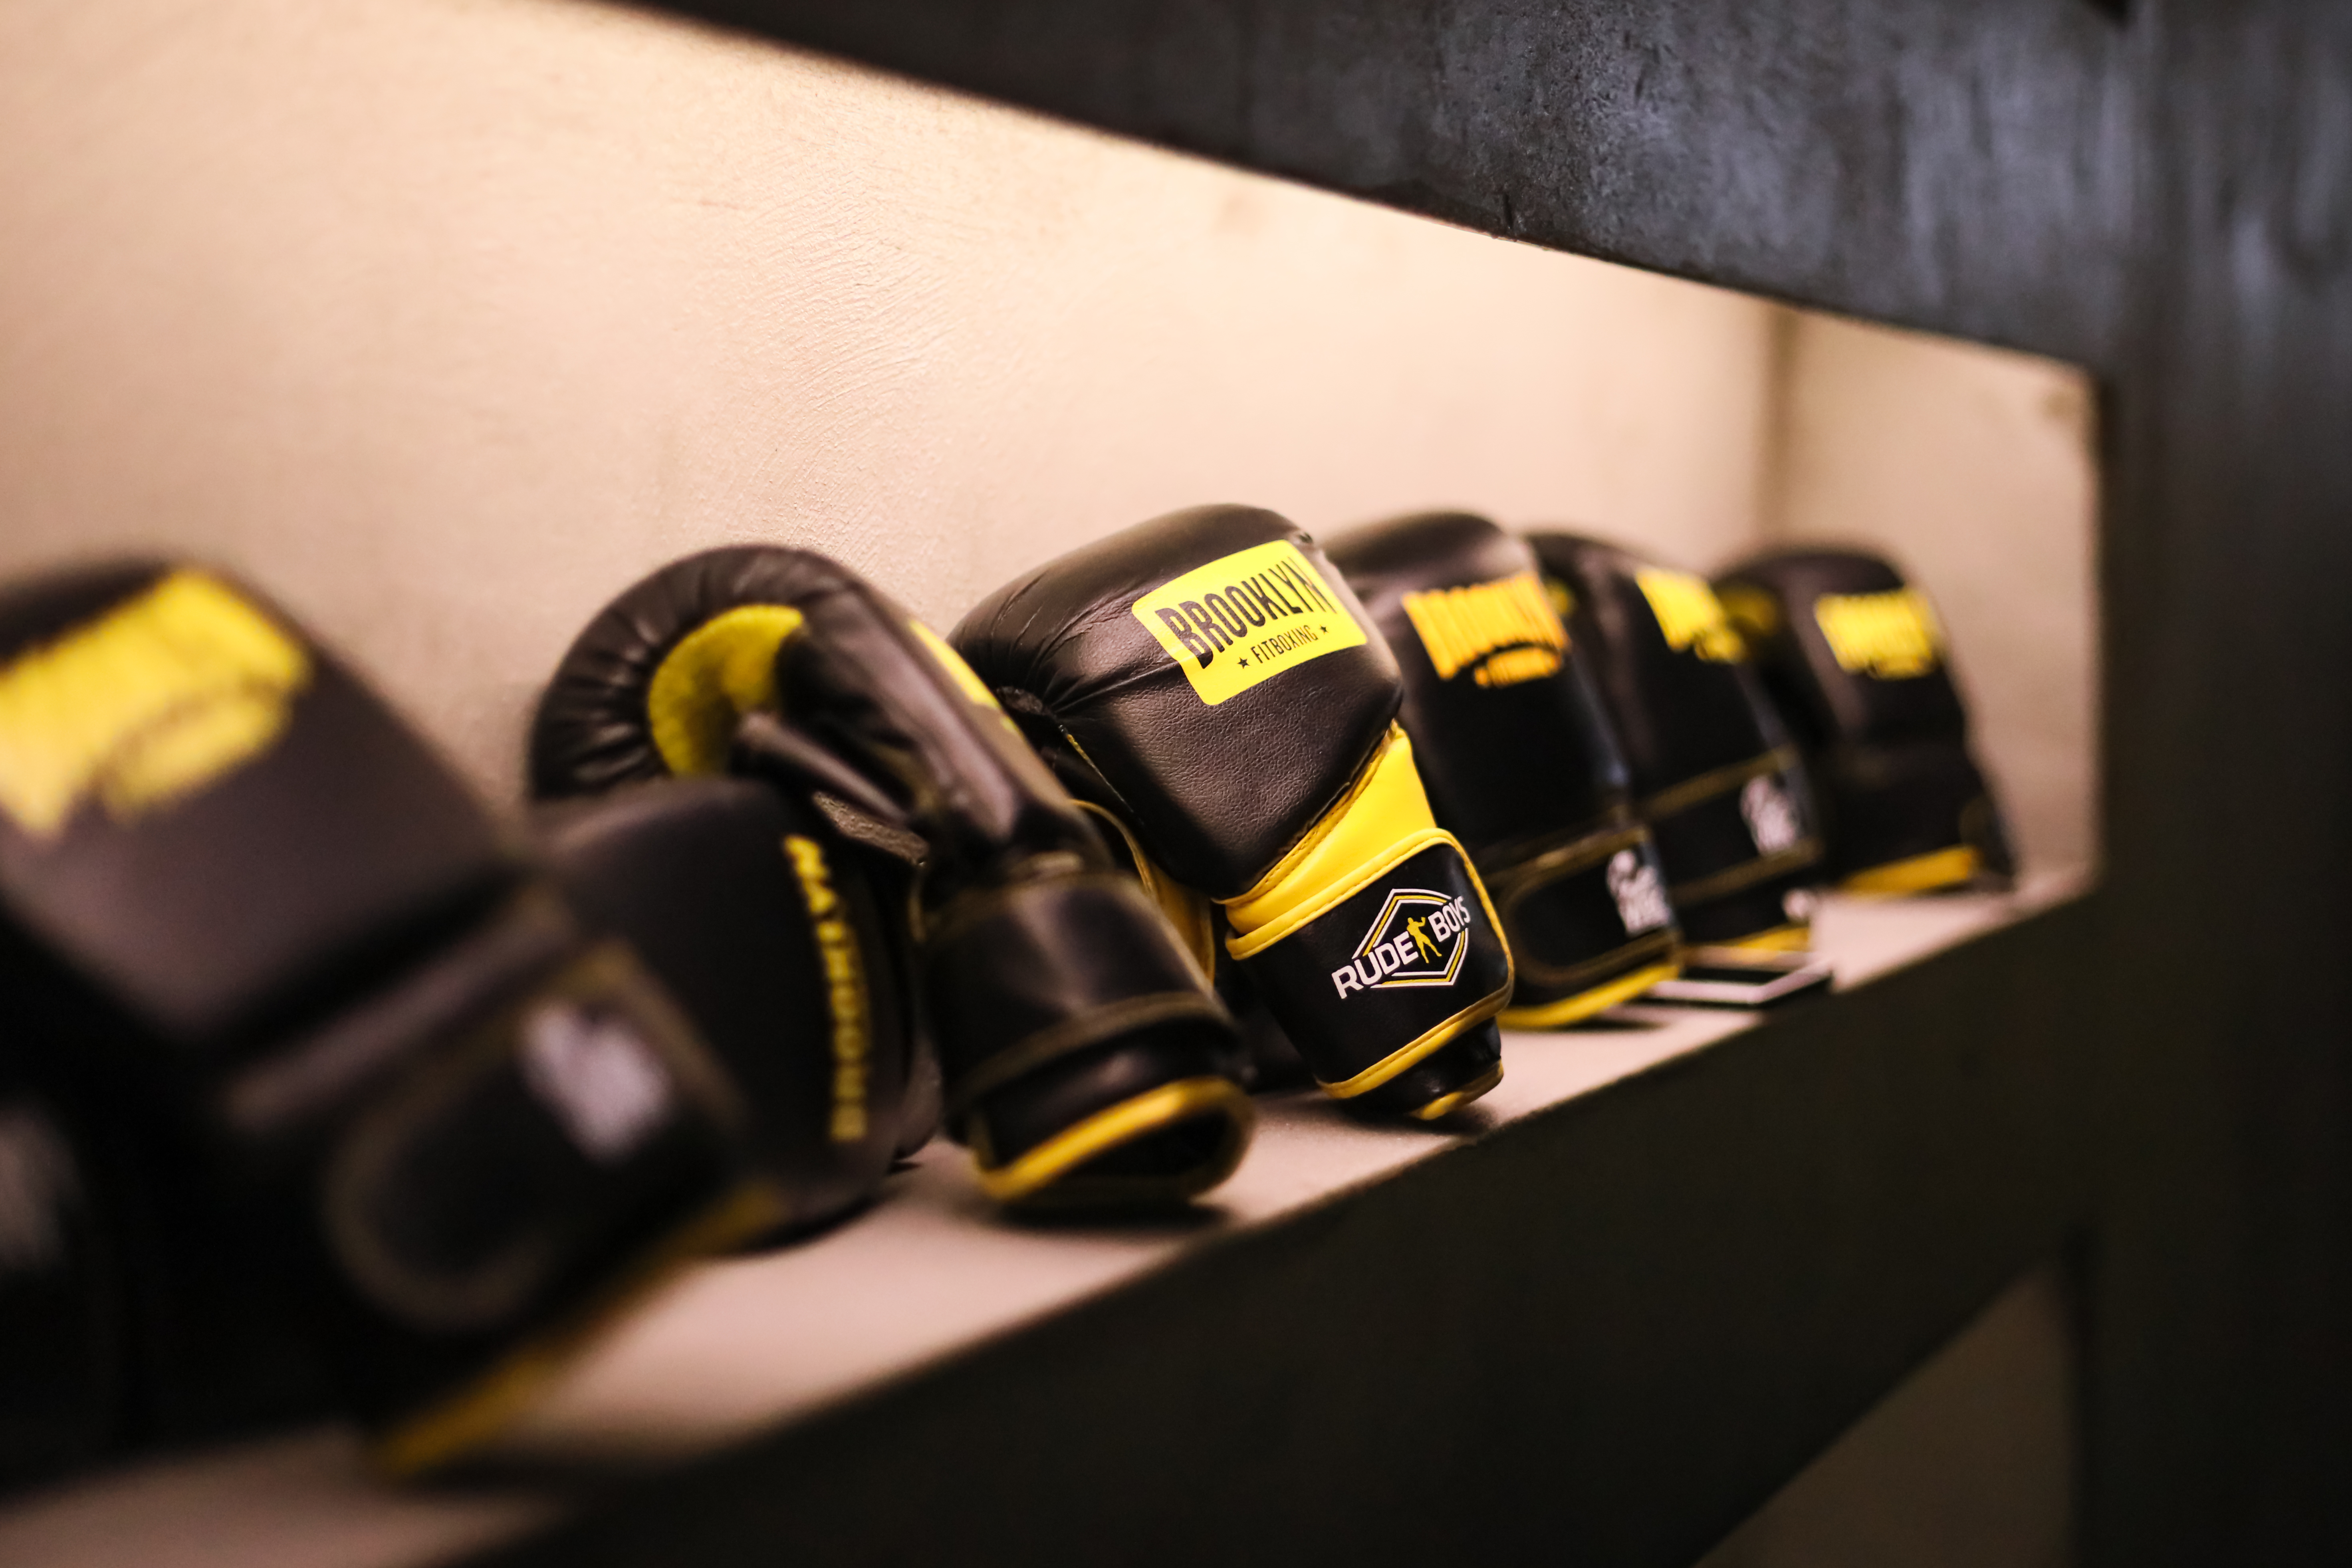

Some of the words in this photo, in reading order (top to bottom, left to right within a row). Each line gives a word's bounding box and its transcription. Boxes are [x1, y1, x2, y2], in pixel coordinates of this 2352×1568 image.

[1155, 557, 1337, 669] BROOKLYN
[1251, 625, 1319, 664] FITBOXING
[1331, 931, 1419, 999] RUDE
[1428, 896, 1471, 942] BOYS
